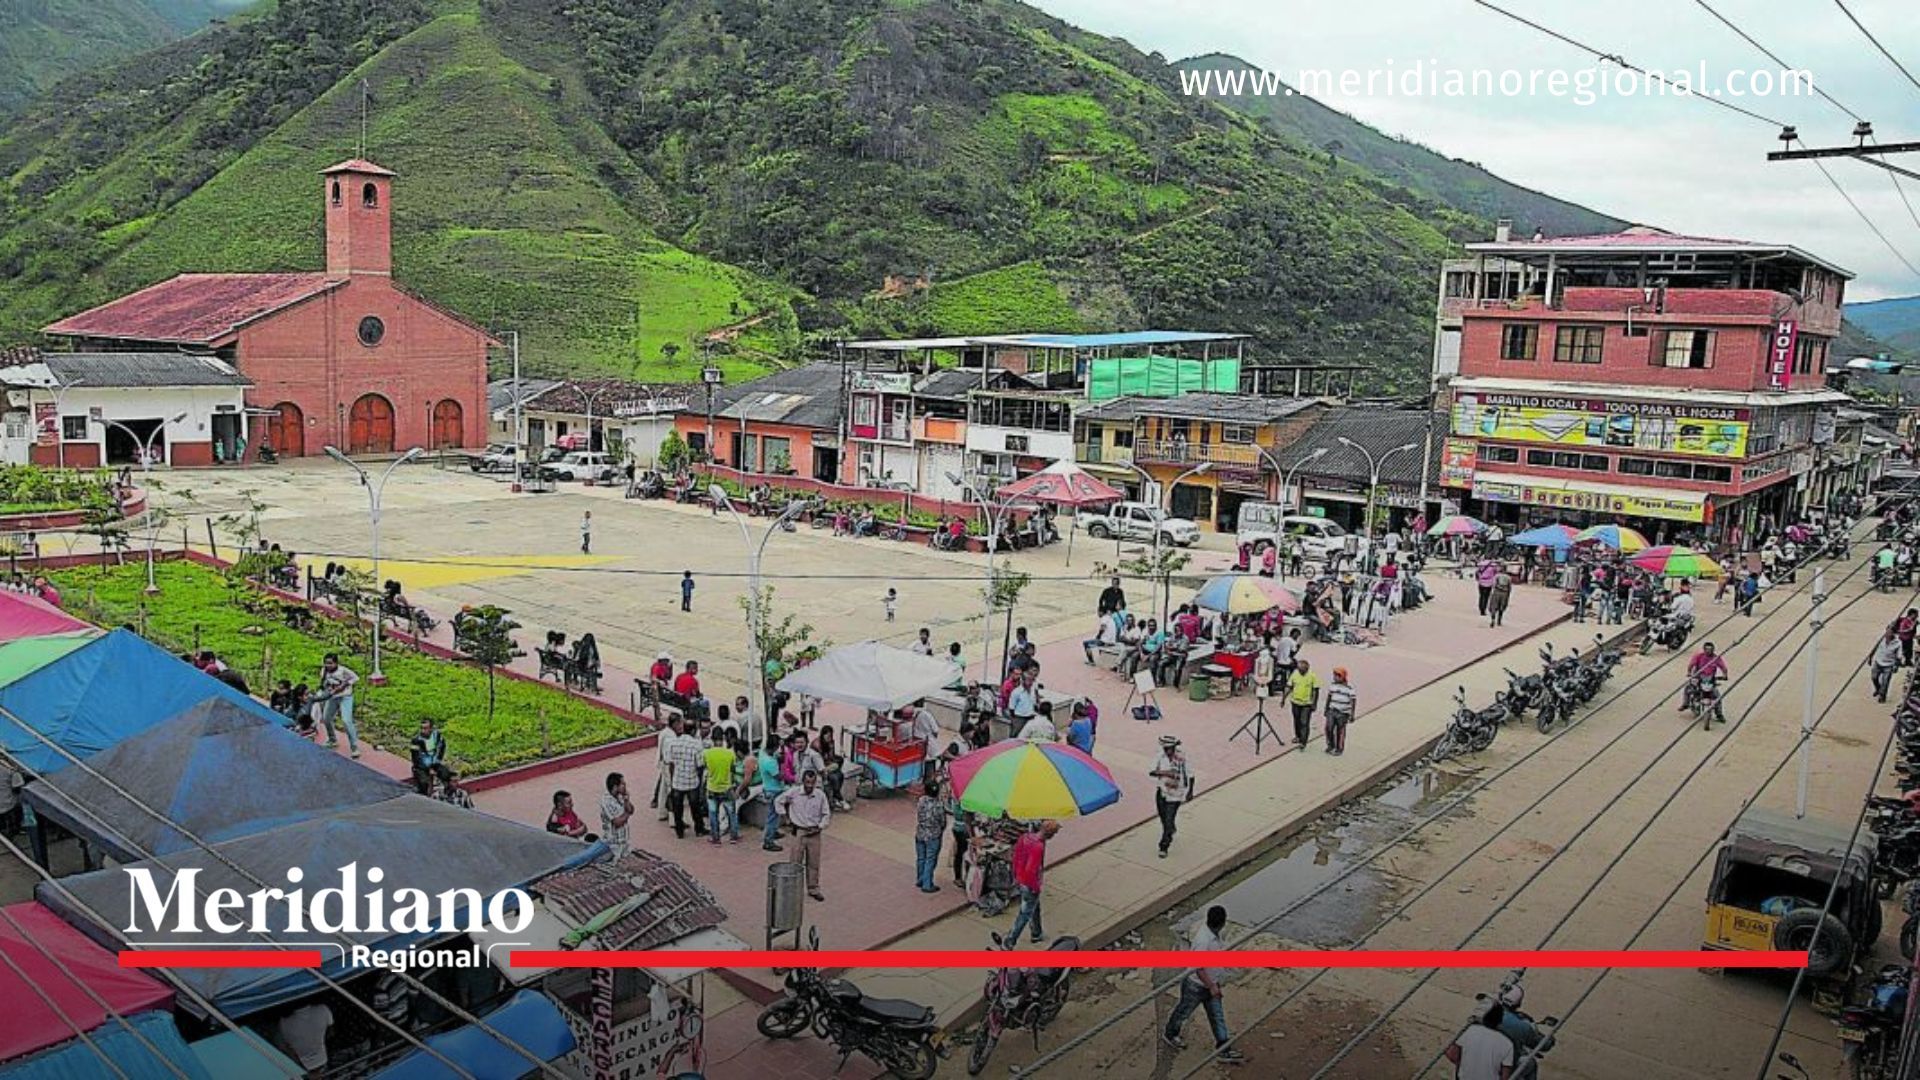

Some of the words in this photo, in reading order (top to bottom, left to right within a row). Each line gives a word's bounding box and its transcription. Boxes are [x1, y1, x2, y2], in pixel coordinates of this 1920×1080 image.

[1772, 321, 1792, 386] HOTEL
[1485, 394, 1539, 408] BARATILLO
[1541, 398, 1577, 410] LOCAL
[1581, 400, 1588, 410] 2
[1604, 402, 1639, 414] TODO
[1640, 404, 1672, 417] PARA
[1675, 406, 1687, 417] EL
[1690, 407, 1736, 420] HOGAR
[1523, 488, 1624, 511] Baratillo
